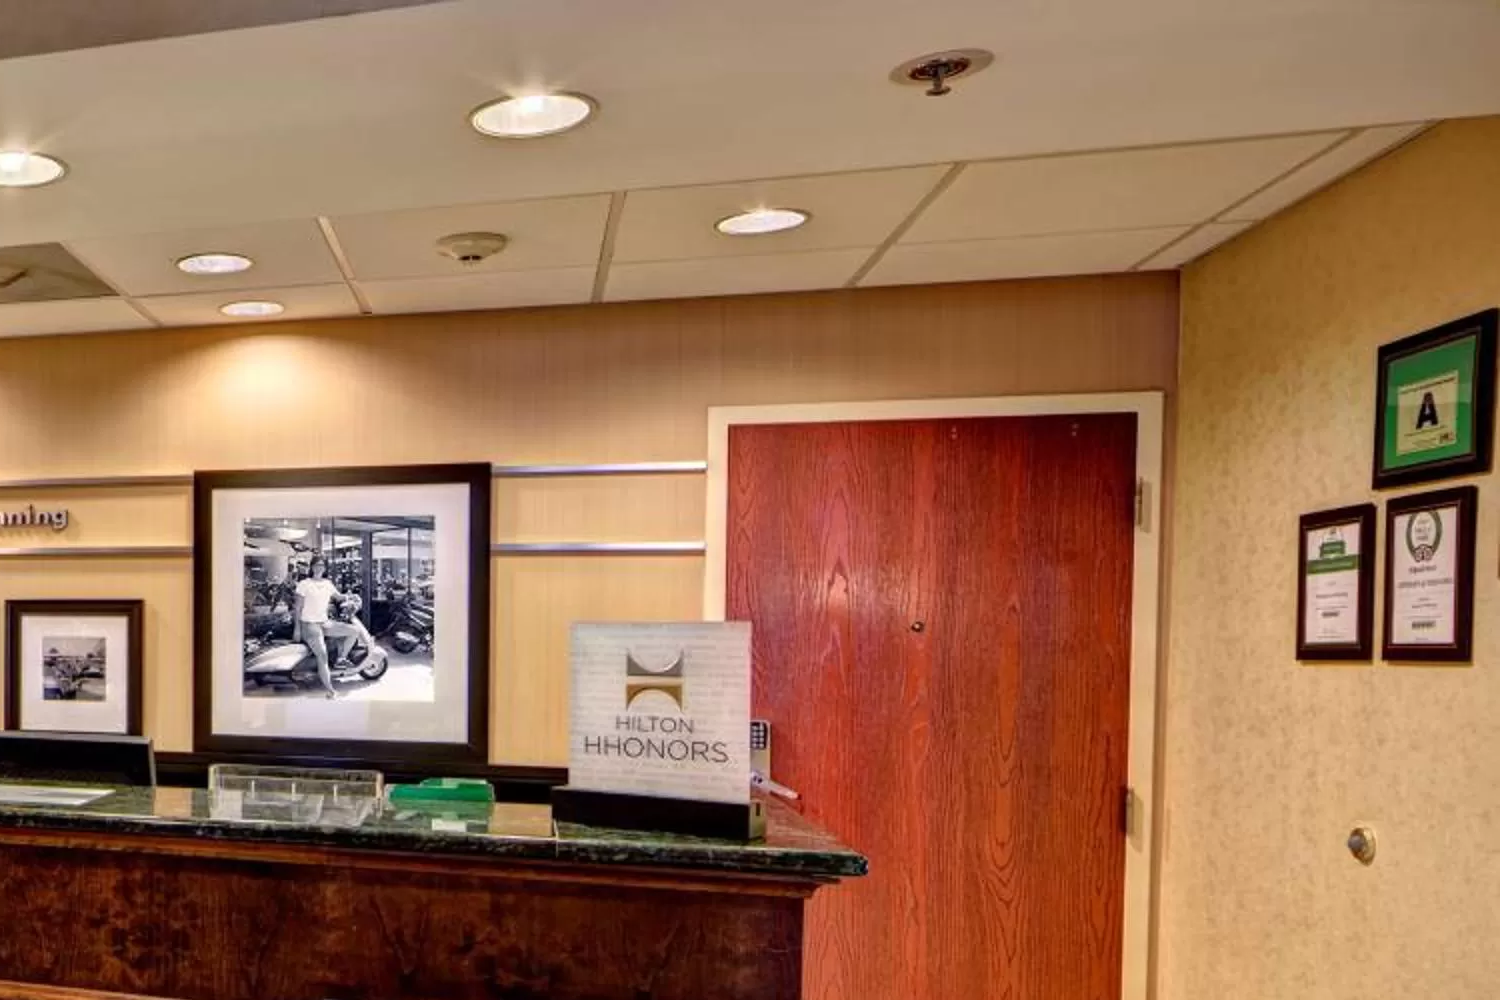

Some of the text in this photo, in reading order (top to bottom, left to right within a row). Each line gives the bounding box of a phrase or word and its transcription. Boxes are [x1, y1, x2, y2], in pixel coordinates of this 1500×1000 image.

[1416, 391, 1439, 430] A
[616, 715, 695, 734] HILTON
[584, 735, 729, 763] HHONORS
